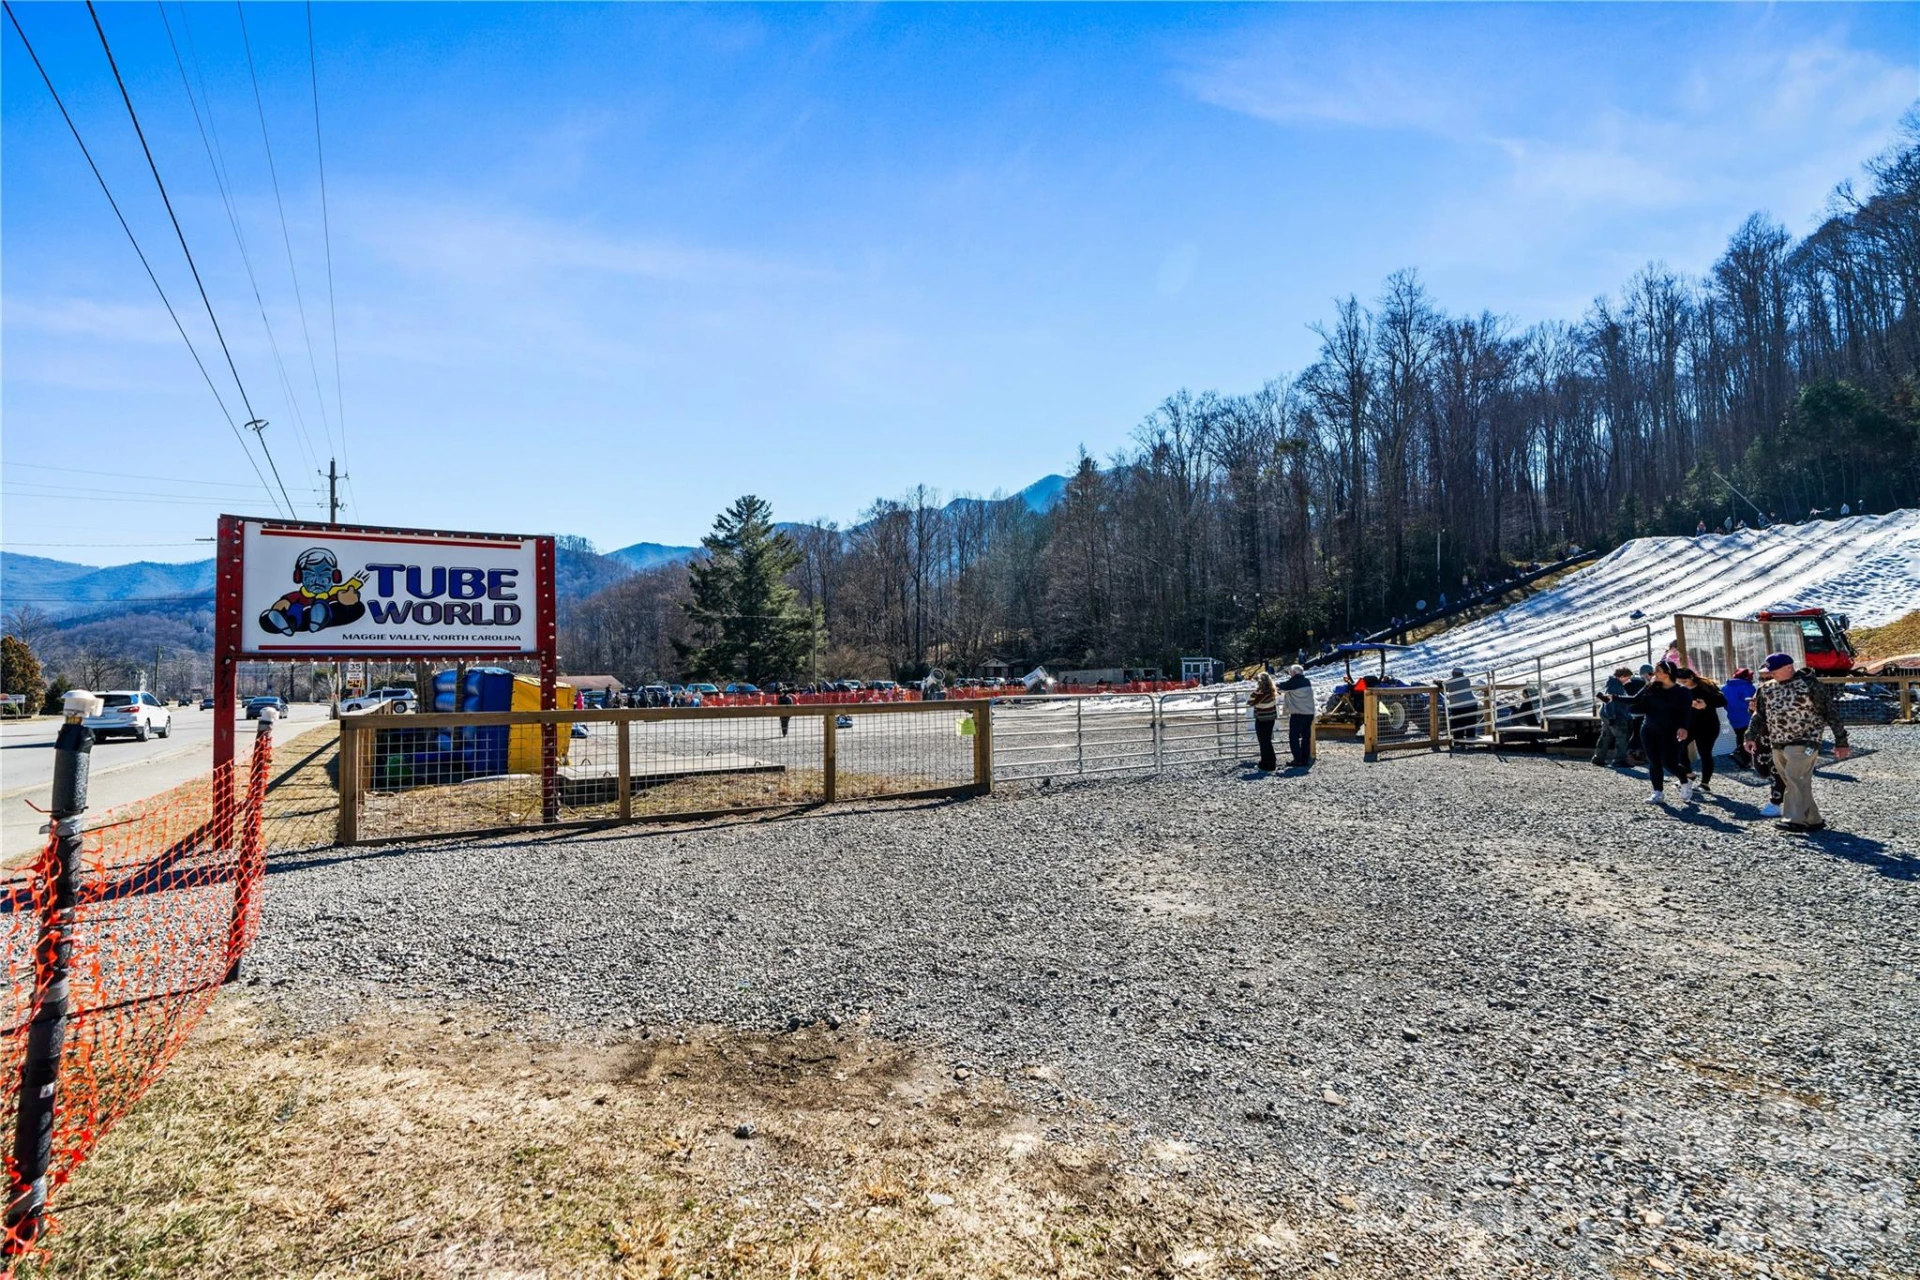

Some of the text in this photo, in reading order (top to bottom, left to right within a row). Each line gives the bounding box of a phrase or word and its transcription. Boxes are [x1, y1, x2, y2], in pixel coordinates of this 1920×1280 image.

[365, 563, 519, 600] TUBE
[366, 599, 522, 626] WORLD
[342, 633, 387, 641] MAGGIE
[389, 634, 431, 642] VALLEY,
[471, 634, 522, 642] CAROLINA
